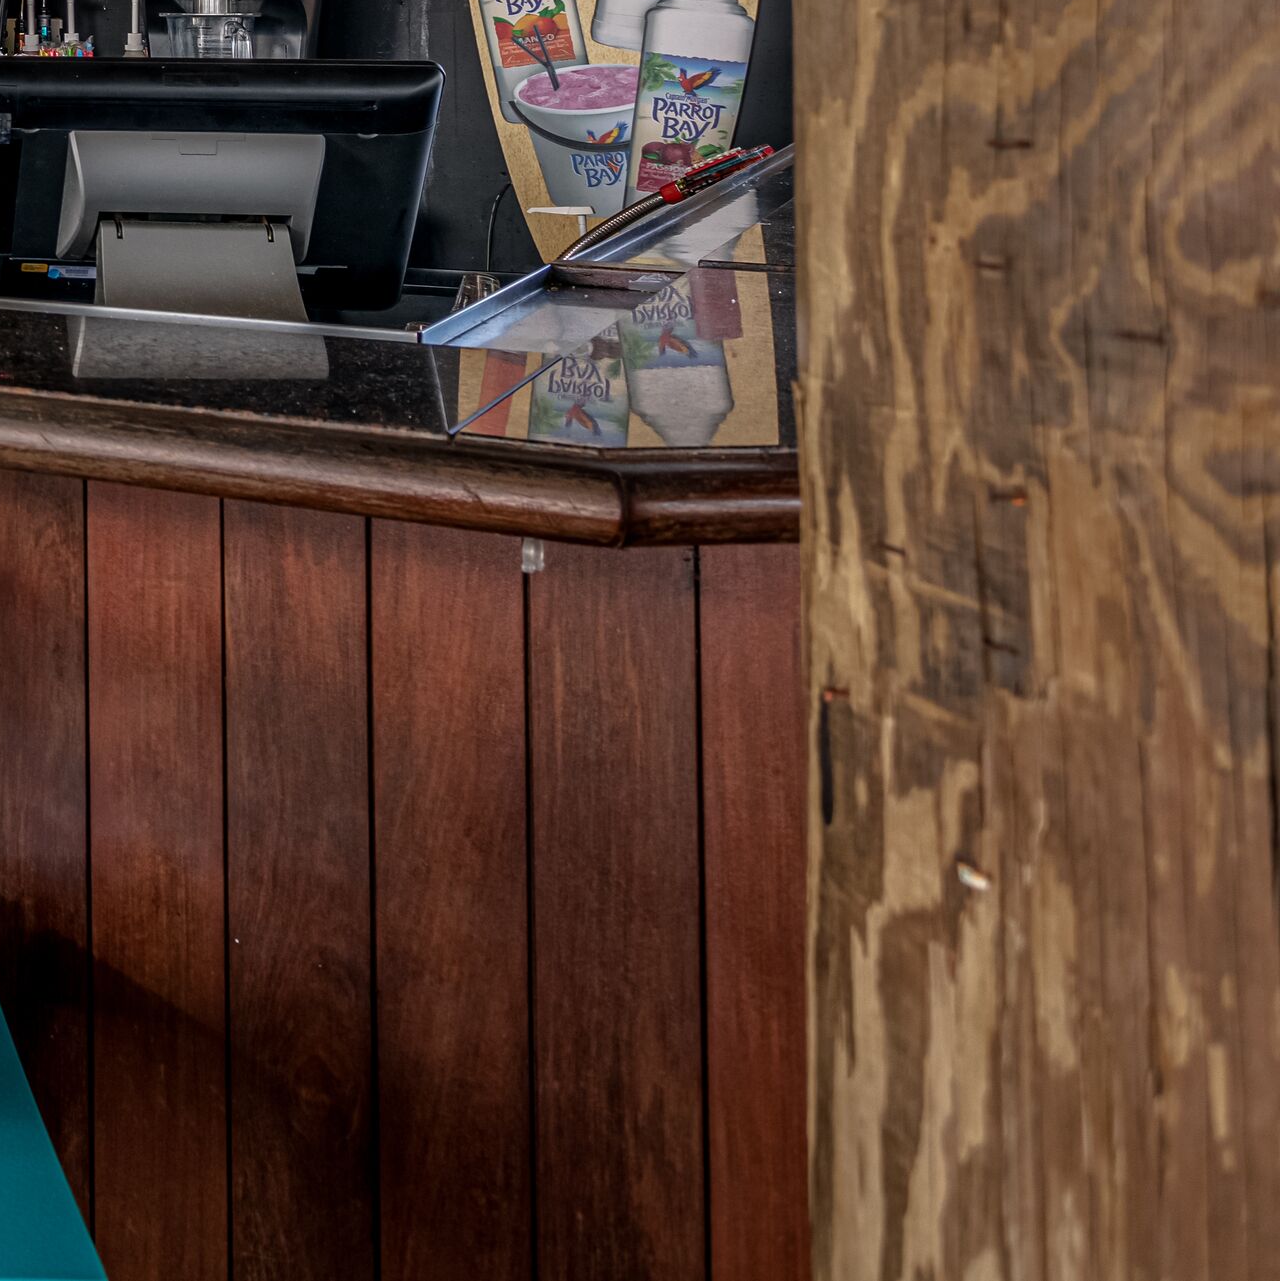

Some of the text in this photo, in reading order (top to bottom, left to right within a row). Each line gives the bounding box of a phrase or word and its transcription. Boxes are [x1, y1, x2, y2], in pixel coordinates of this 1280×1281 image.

[652, 97, 727, 130] PARROT
[661, 117, 713, 142] BAY
[571, 151, 626, 176] PARRO
[585, 163, 624, 188] BAY
